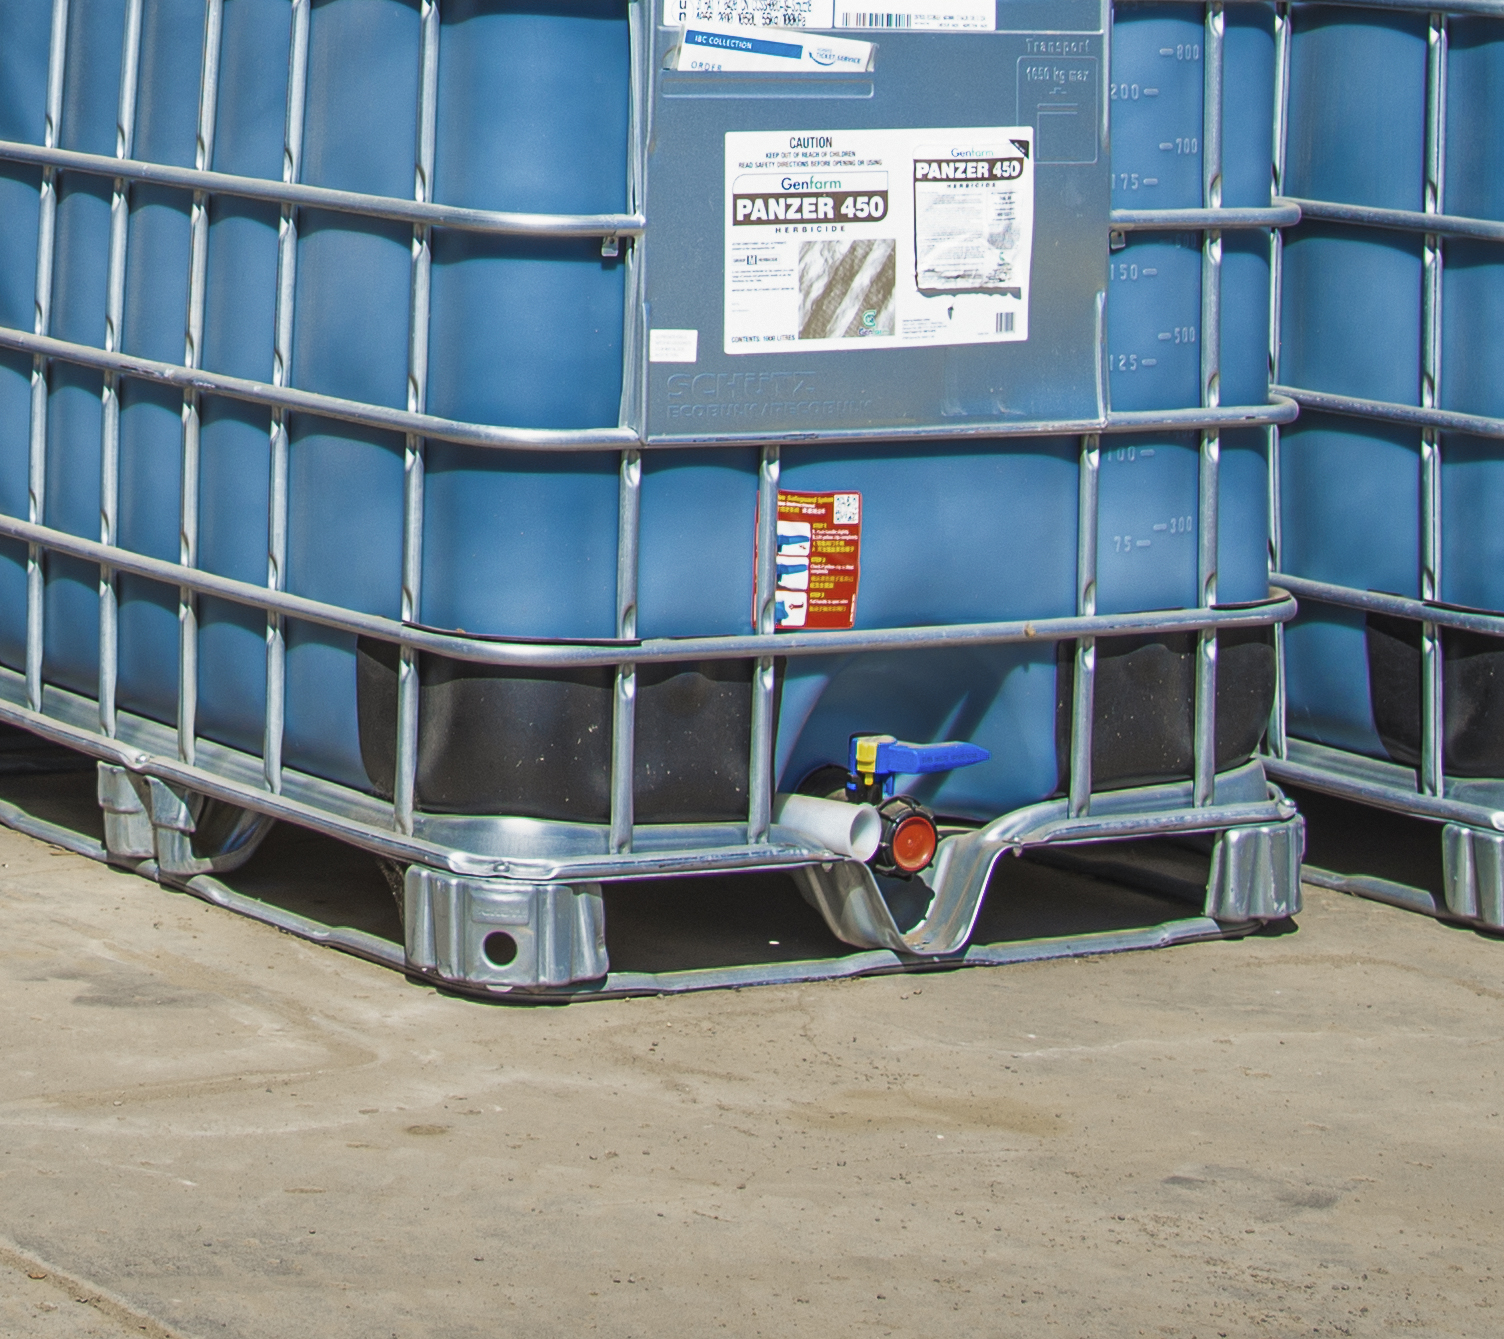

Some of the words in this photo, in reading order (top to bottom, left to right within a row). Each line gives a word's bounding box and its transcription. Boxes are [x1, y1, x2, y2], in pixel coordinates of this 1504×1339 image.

[694, 35, 707, 43] IBC
[709, 37, 752, 50] COLLECTION
[1025, 38, 1089, 56] Transport
[691, 61, 722, 71] ORDER
[815, 52, 835, 60] TICKET
[837, 55, 861, 64] SERVICE
[789, 136, 832, 149] CAUTION
[765, 151, 779, 159] KEEP
[829, 150, 856, 158] CHILDREN
[951, 147, 993, 158] Genfarm
[777, 160, 809, 168] DIRECTIONS
[832, 159, 856, 167] OPENING
[915, 161, 989, 179] PANZER
[992, 160, 1021, 178] 450
[781, 175, 842, 191] Genfarm
[1111, 173, 1138, 190] 175
[736, 196, 834, 221] PANZER
[840, 195, 885, 219] 450
[775, 225, 846, 234] HERBICIDE
[1110, 264, 1138, 281] 150
[1173, 327, 1196, 344] 500
[1109, 355, 1138, 371] 125
[1113, 536, 1132, 552] 75
